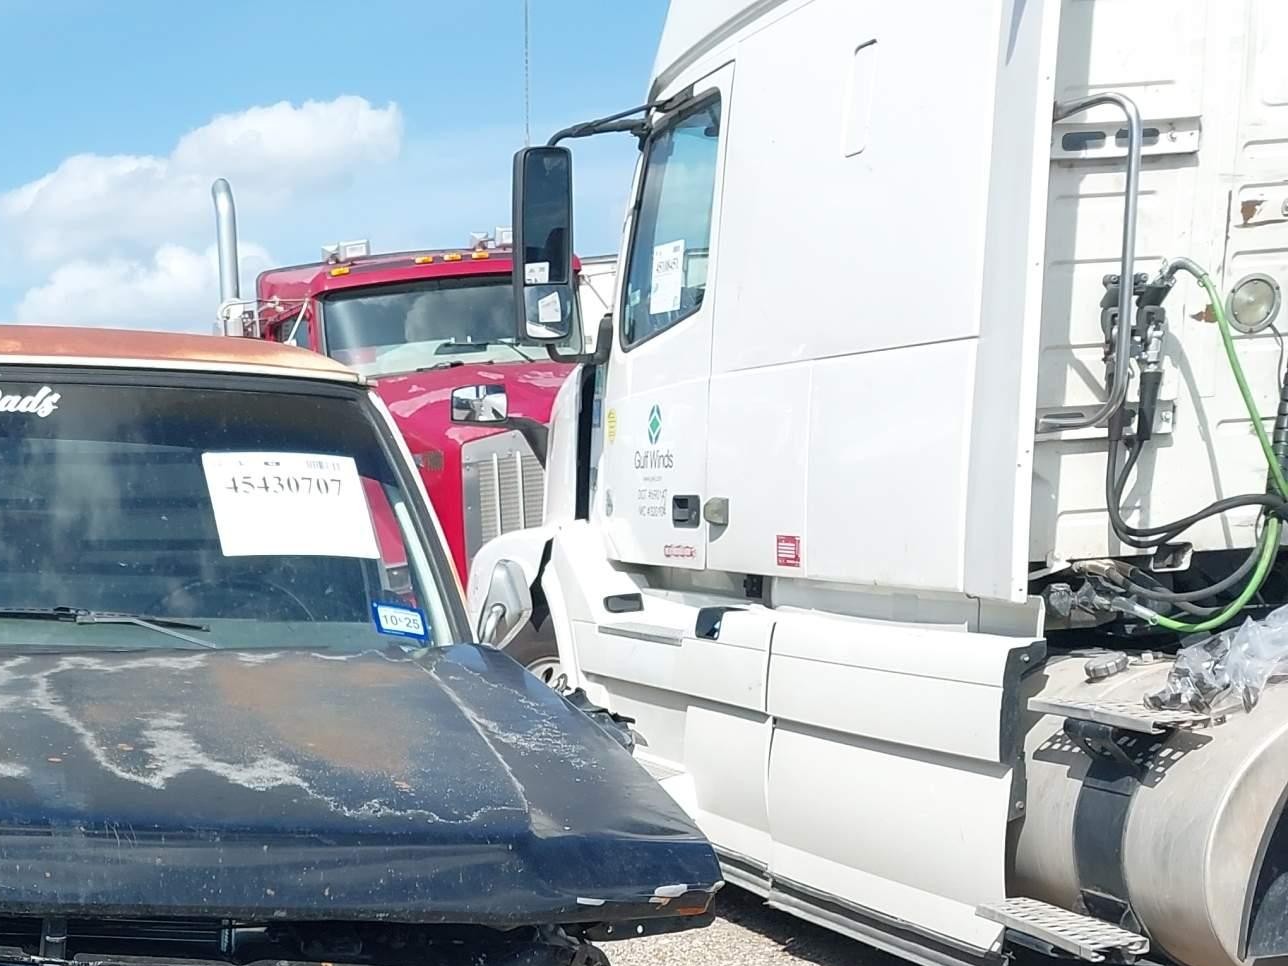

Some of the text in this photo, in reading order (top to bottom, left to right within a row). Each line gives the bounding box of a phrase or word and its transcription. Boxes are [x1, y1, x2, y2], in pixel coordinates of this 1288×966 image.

[634, 449, 674, 469] Gulf Winds
[226, 476, 341, 496] 45430707
